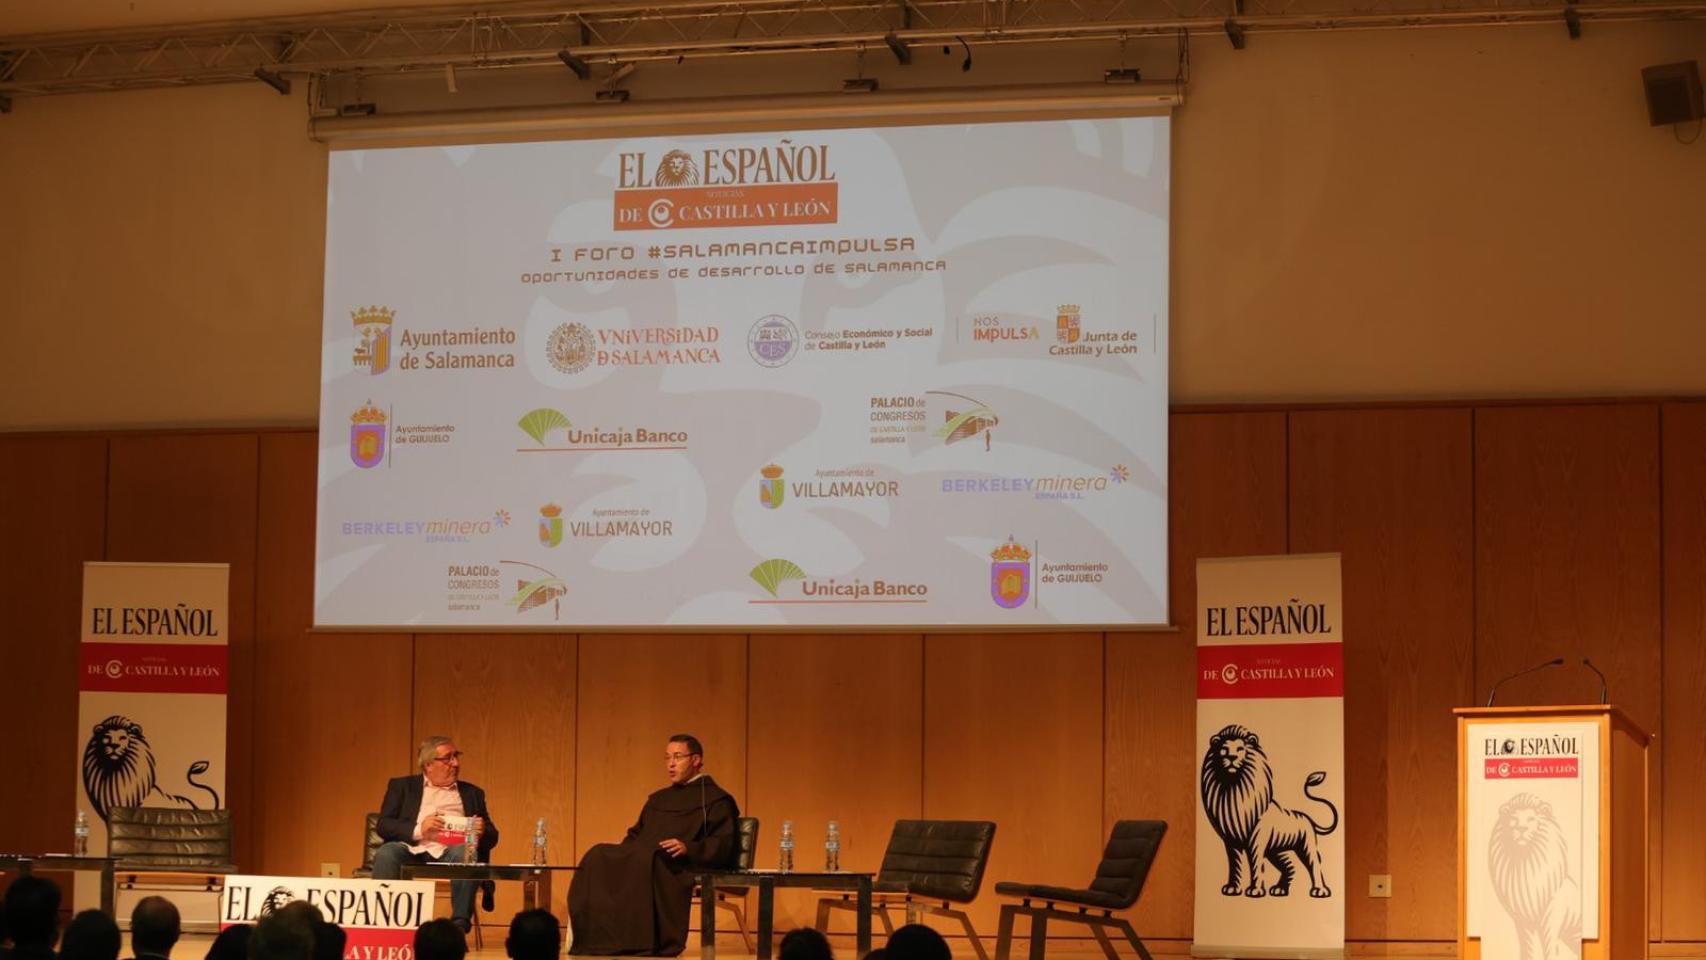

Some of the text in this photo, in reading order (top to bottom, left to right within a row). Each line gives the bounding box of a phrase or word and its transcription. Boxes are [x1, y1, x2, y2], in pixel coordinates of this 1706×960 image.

[619, 139, 835, 188] EL ESPAÑOL
[620, 198, 832, 223] DE CASTILLA Y LEÓN
[551, 248, 562, 263] I
[974, 316, 1000, 327] NOS
[400, 327, 516, 350] Ayuntamiento
[804, 327, 933, 340] Consejo Económico y Social
[974, 326, 1039, 343] IMPULSA
[1082, 331, 1137, 342] Junta de
[804, 340, 886, 351] de Castilla y León
[1049, 343, 1137, 357] Castilla y León
[400, 351, 515, 370] de Salamanca
[611, 348, 721, 365] SALAMANCA
[871, 396, 926, 408] PALACIO de
[870, 410, 926, 422] CONGRESOS
[395, 424, 455, 434] Ayuntamiento
[567, 427, 688, 446] Unicaja Banco
[395, 435, 406, 443] de
[792, 481, 899, 498] VILLAMAYOR
[570, 520, 673, 537] VILLAMAYOR
[448, 565, 500, 577] PALACIO de
[1042, 562, 1108, 573] Ayuntamiento
[448, 579, 500, 589] CONGRESOS
[1042, 574, 1055, 583] de
[802, 578, 927, 599] Unicaja Banco
[92, 603, 218, 637] EL ESPAÑOL
[1206, 598, 1332, 637] EL ESPAÑOL
[88, 663, 220, 677] DE CASTILLA Y LEÓN
[1203, 664, 1335, 681] DE CASTILLA Y LEÓN
[1485, 734, 1579, 756] EL ESPAÑOL
[1486, 766, 1497, 774] DE
[1511, 765, 1548, 774] CASTILLA
[1556, 763, 1577, 773] LEÓN
[226, 885, 257, 922] EL
[377, 943, 414, 960] LEÓ
